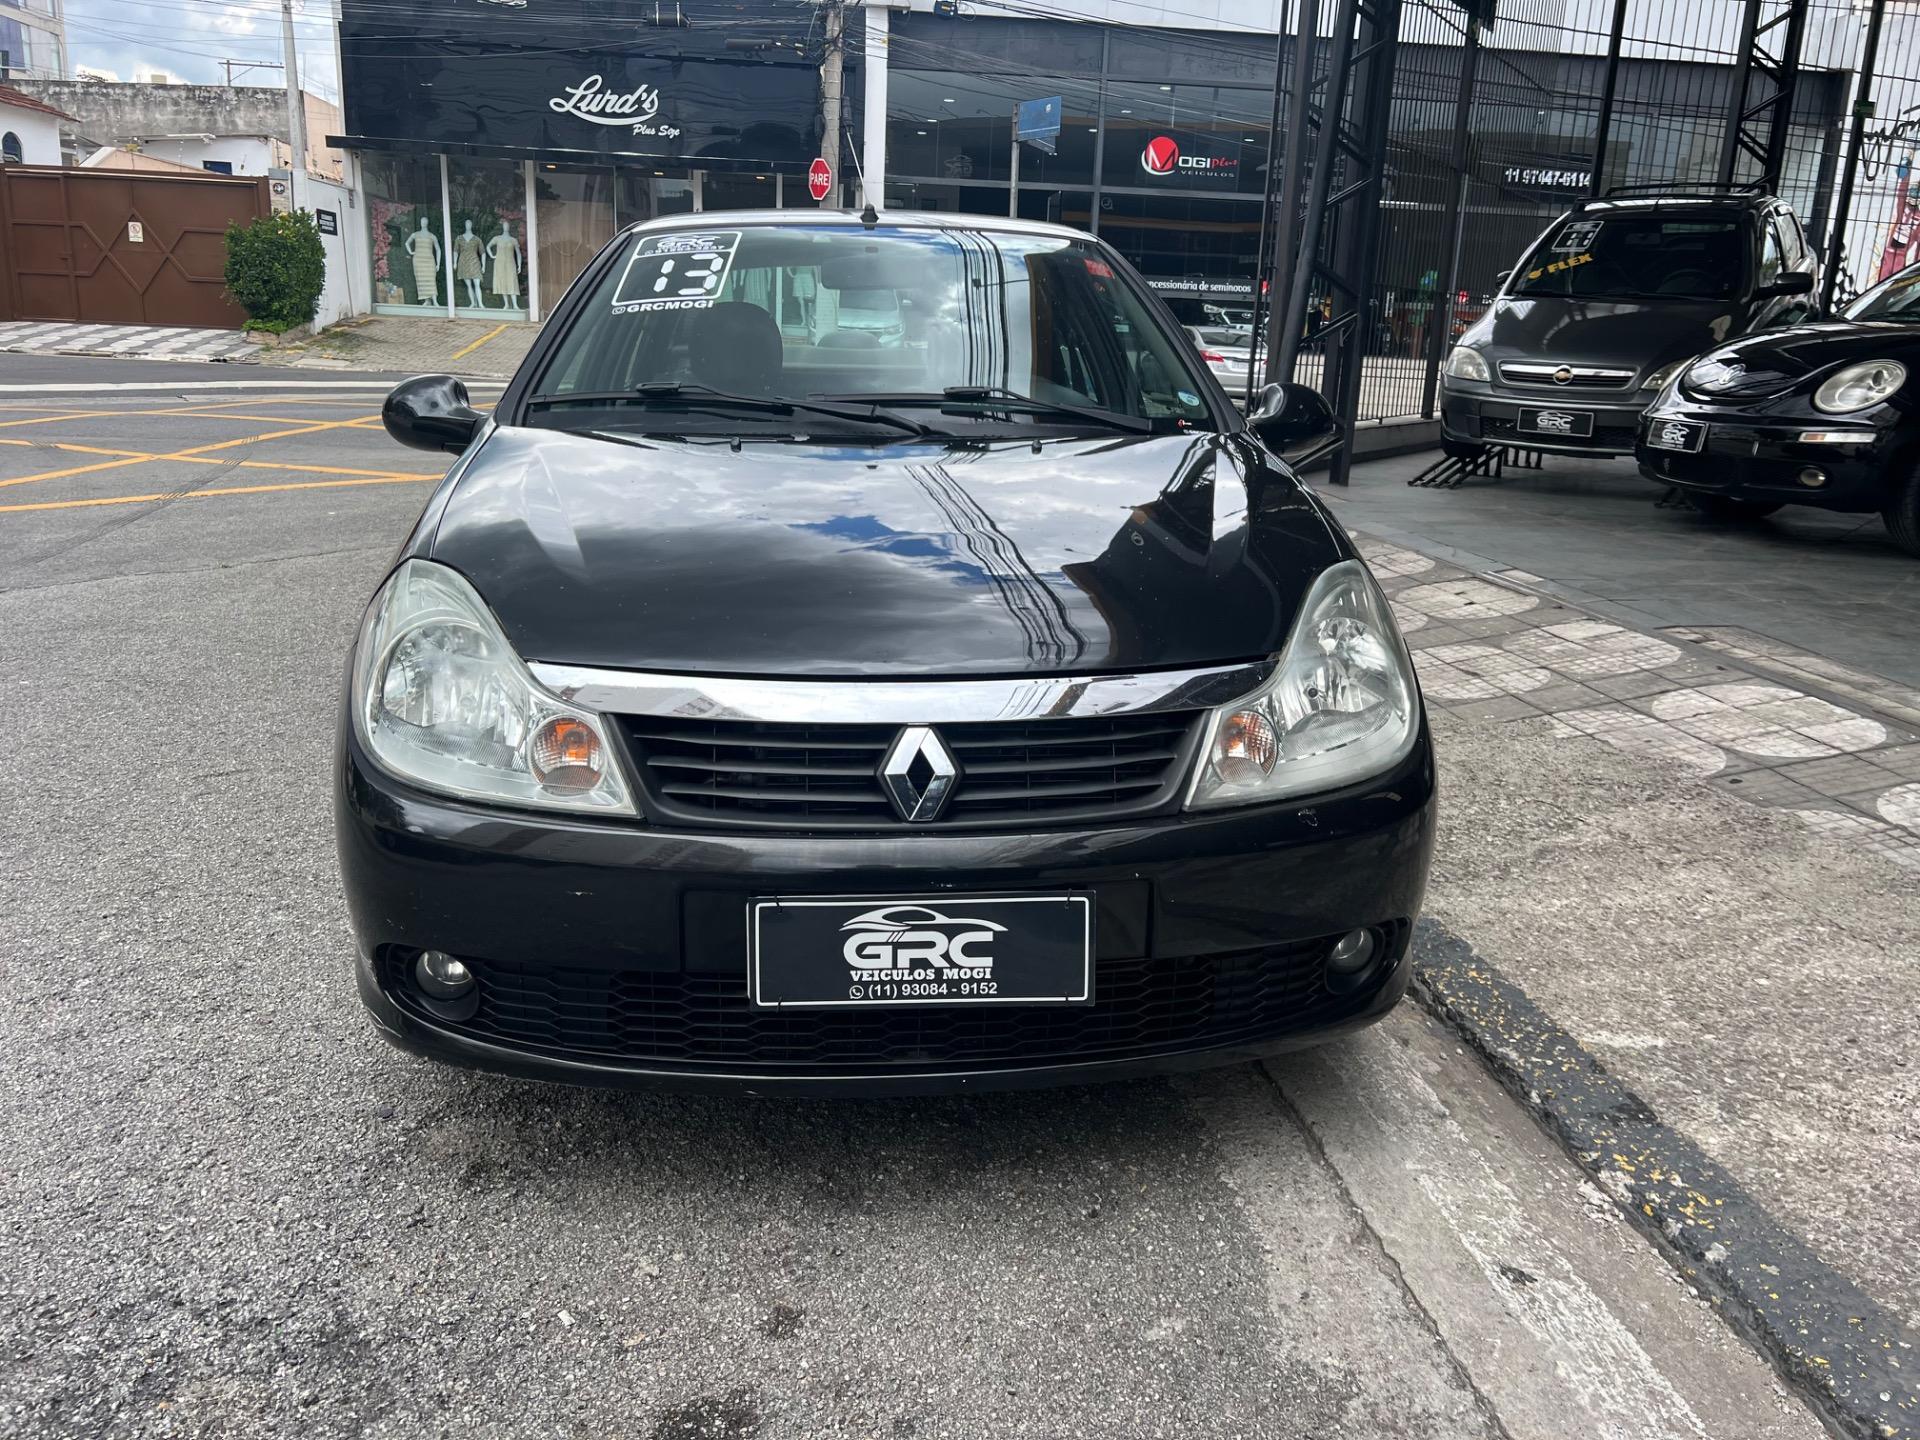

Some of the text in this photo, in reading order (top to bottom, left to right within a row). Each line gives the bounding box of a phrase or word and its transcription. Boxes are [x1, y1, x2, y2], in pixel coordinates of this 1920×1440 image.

[549, 74, 659, 125] Lurd's
[633, 124, 680, 138] Plus Size
[810, 173, 829, 185] PARE
[1505, 168, 1520, 182] 11
[1547, 253, 1593, 274] FLEX
[653, 252, 724, 296] 13
[1145, 280, 1198, 290] ncessionária
[1198, 281, 1209, 290] de
[626, 300, 714, 313] GRCMOGI
[1536, 415, 1572, 428] GRC
[1662, 428, 1688, 441] GRC
[843, 930, 994, 969] GRC
[850, 967, 992, 982] VEICULOS MOGI
[868, 983, 898, 999] (11)
[901, 983, 949, 996] 93084
[960, 982, 998, 996] 9152
